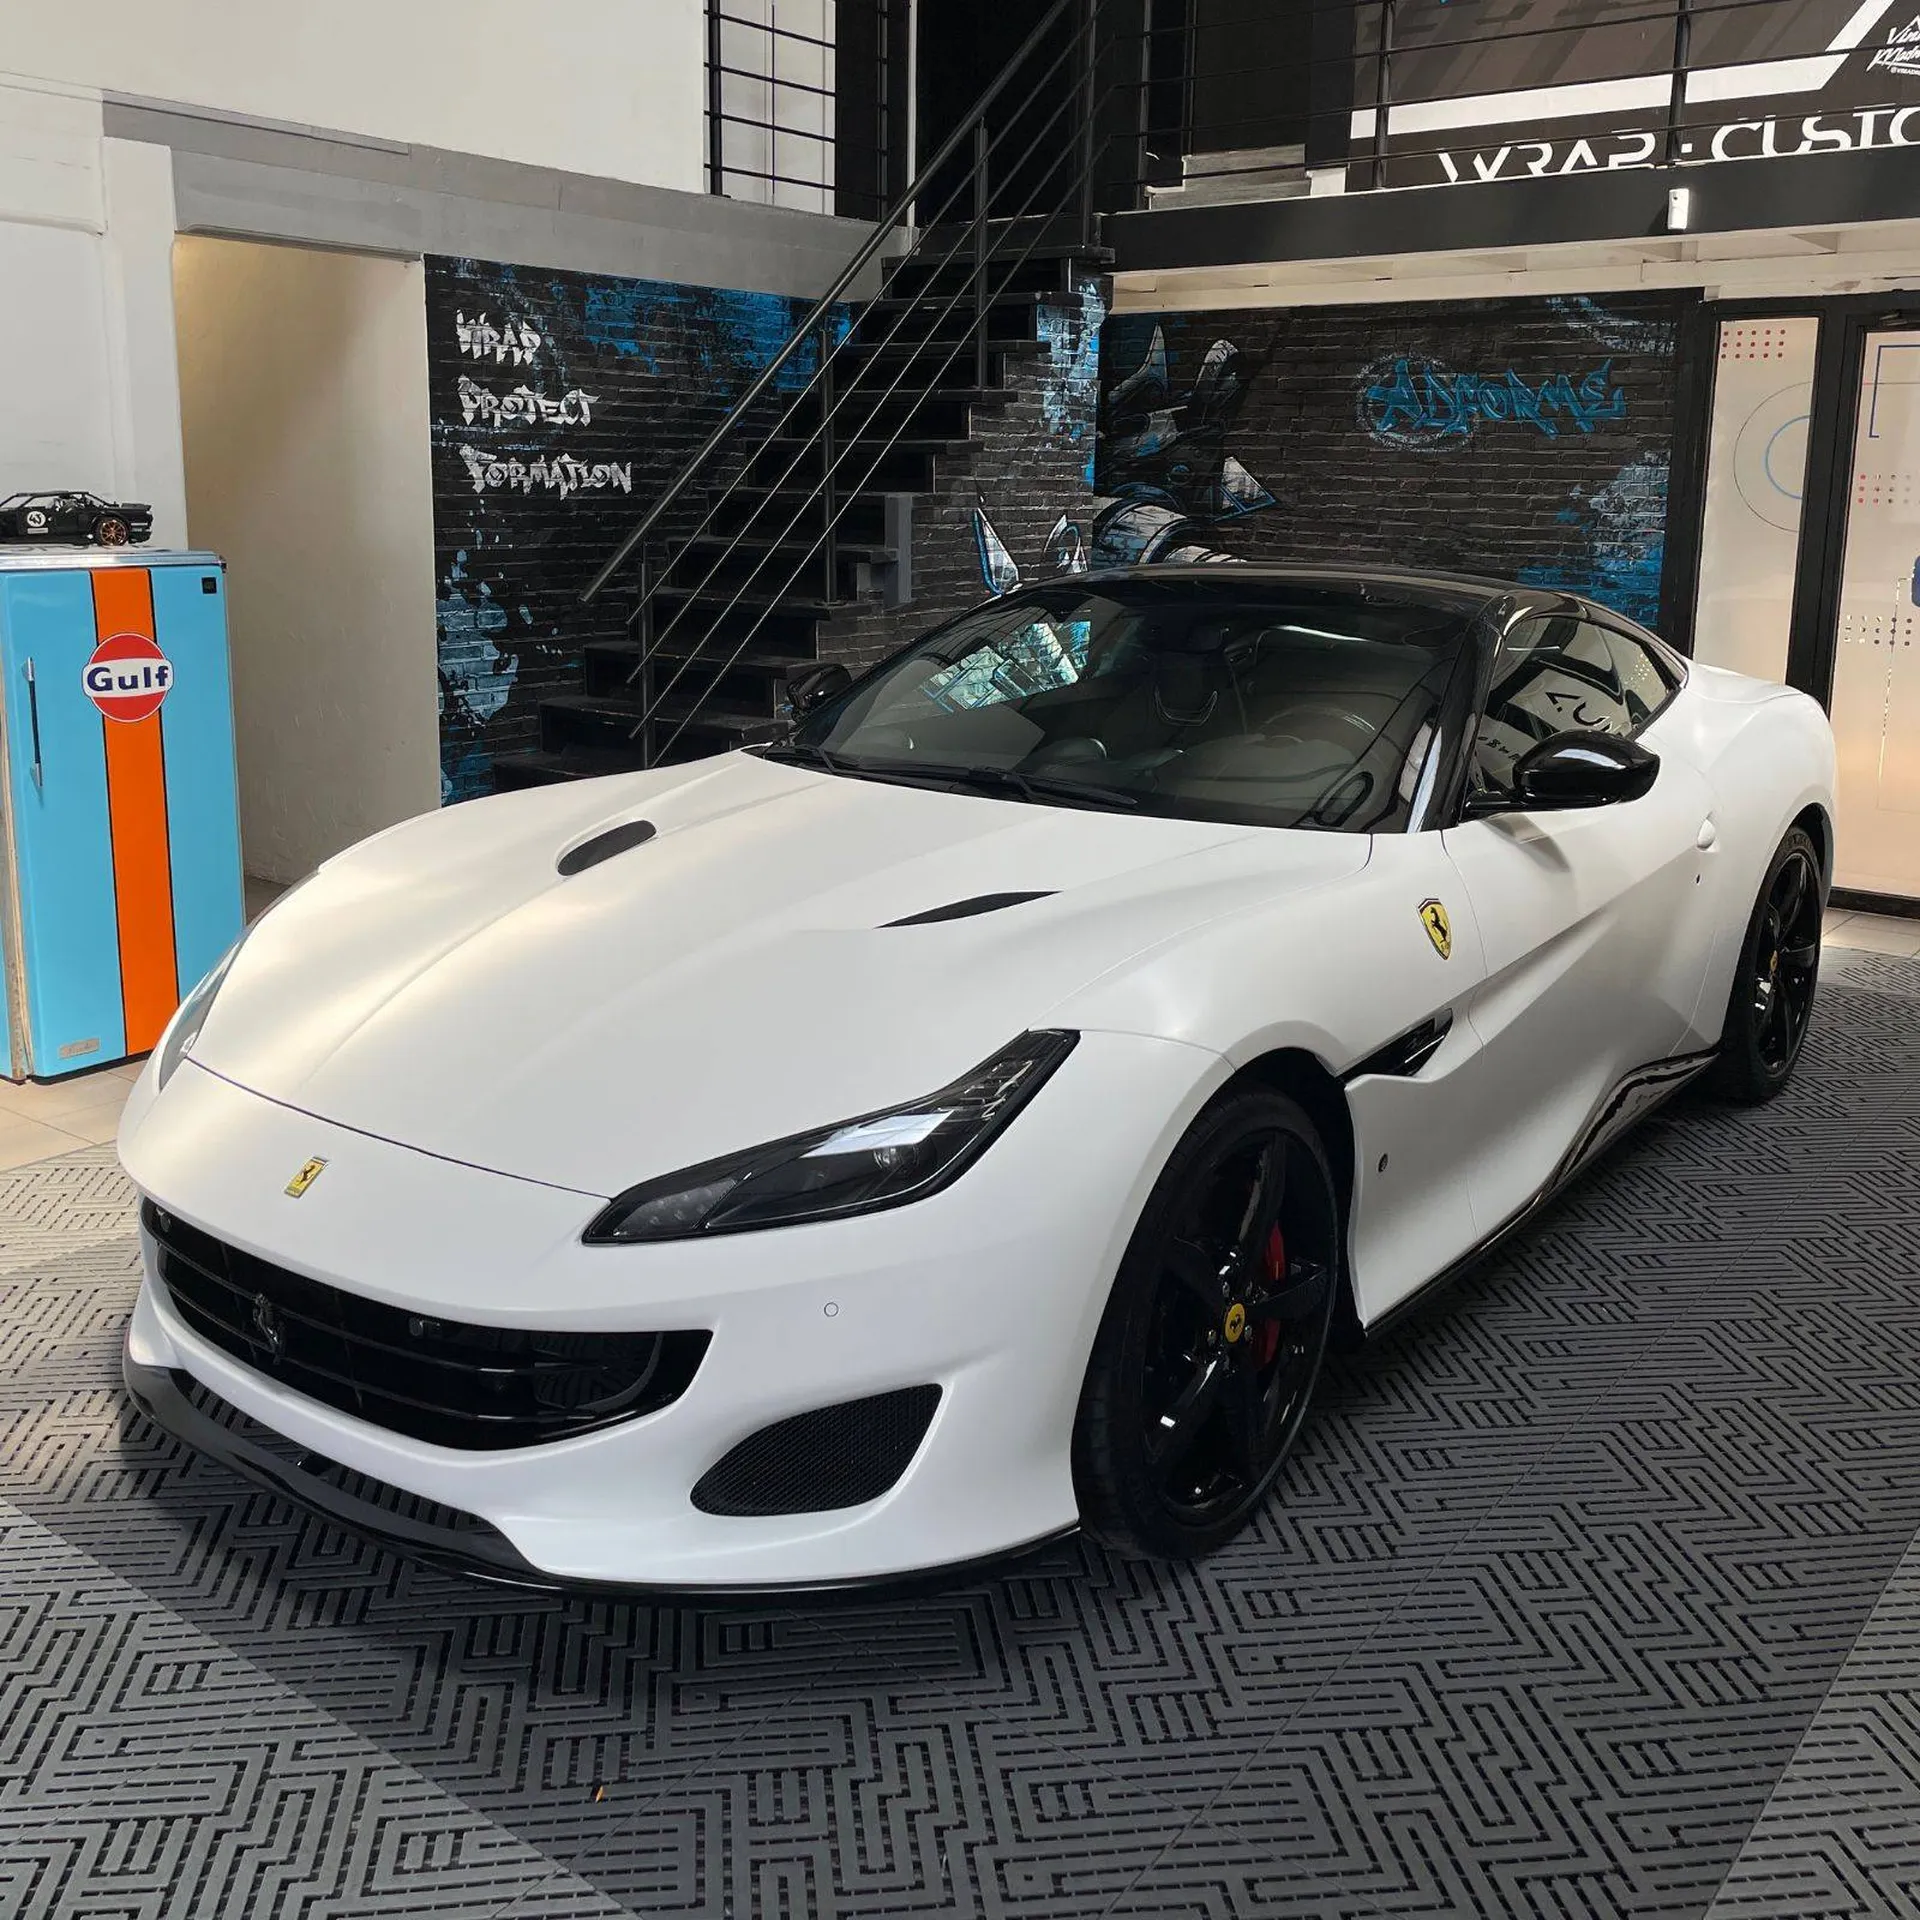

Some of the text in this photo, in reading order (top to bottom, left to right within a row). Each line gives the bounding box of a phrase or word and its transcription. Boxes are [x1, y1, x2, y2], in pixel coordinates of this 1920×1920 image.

[1437, 128, 1656, 183] WRAP
[456, 309, 542, 366] WRAP
[458, 374, 600, 427] PROTECT
[87, 666, 169, 691] Gulf
